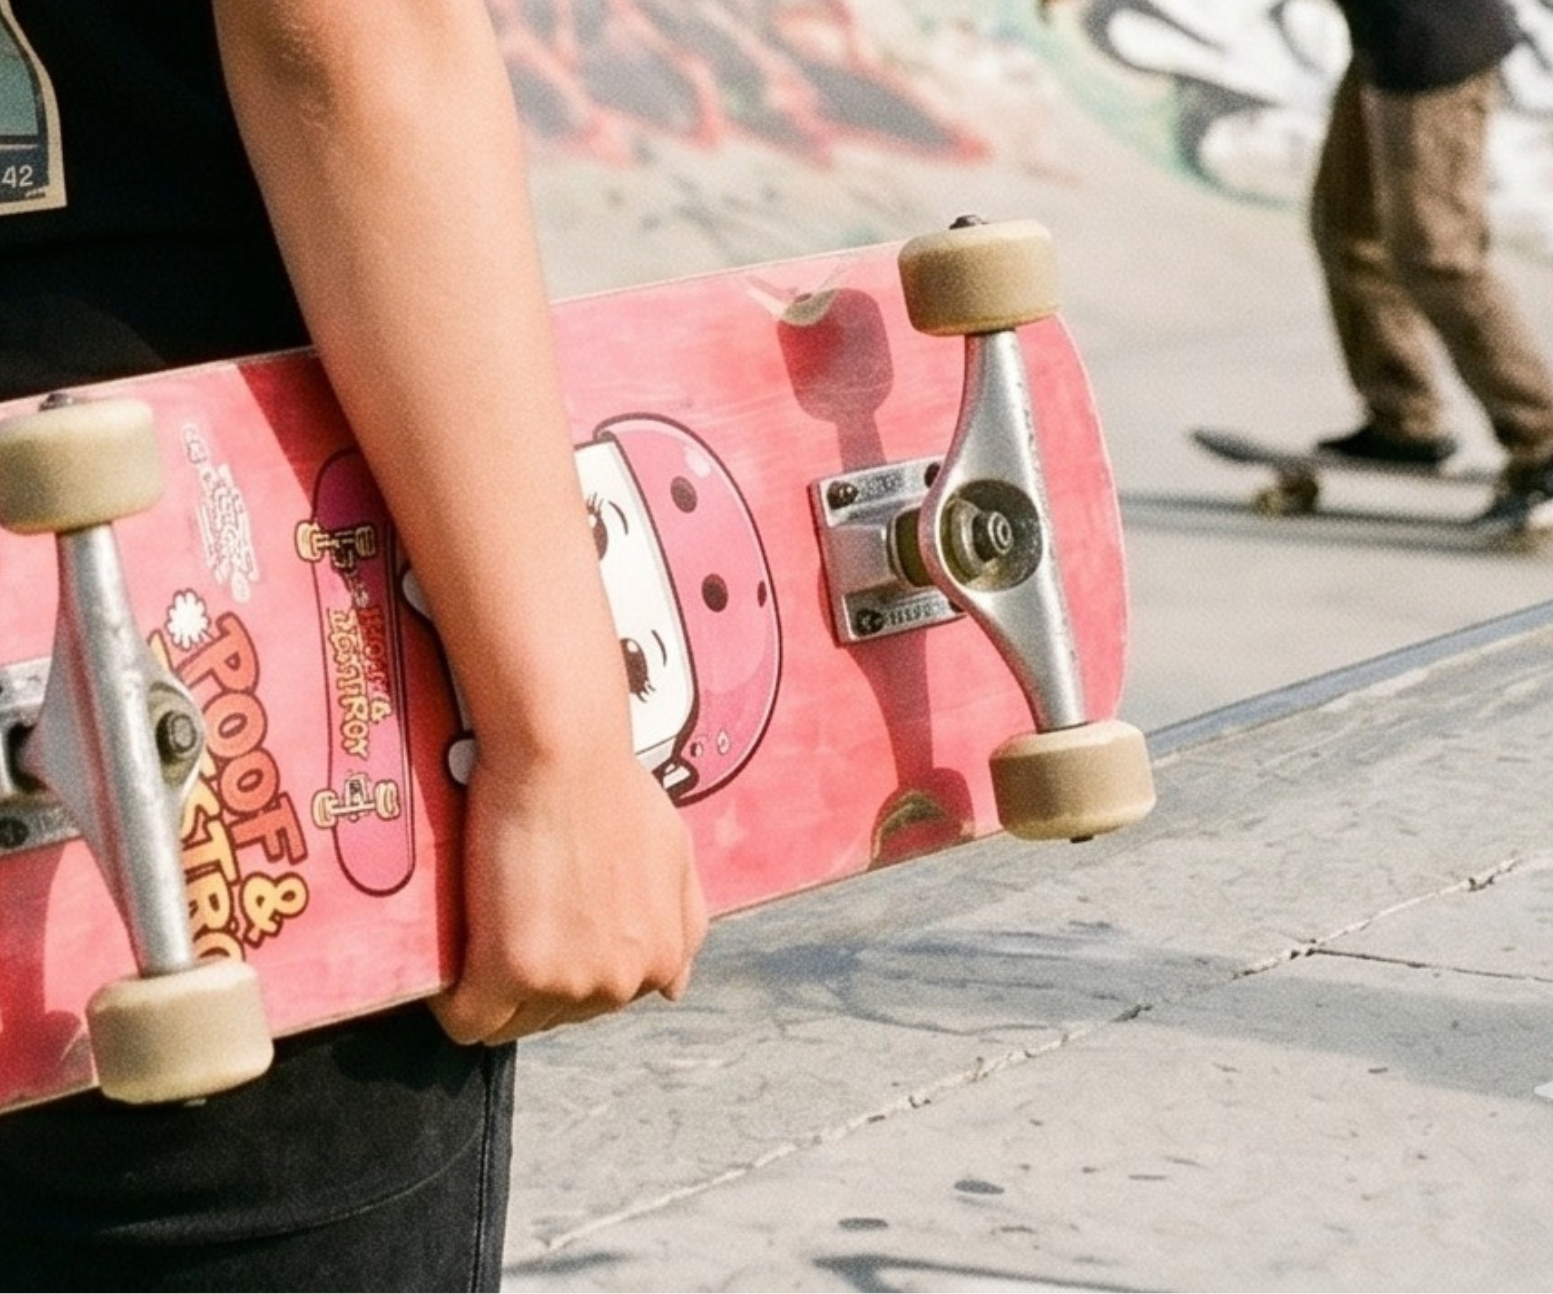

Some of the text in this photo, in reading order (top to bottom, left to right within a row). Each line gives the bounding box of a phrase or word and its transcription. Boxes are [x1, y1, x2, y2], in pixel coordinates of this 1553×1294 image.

[2, 164, 34, 190] 42
[174, 611, 309, 865] POOF
[238, 871, 310, 949] &
